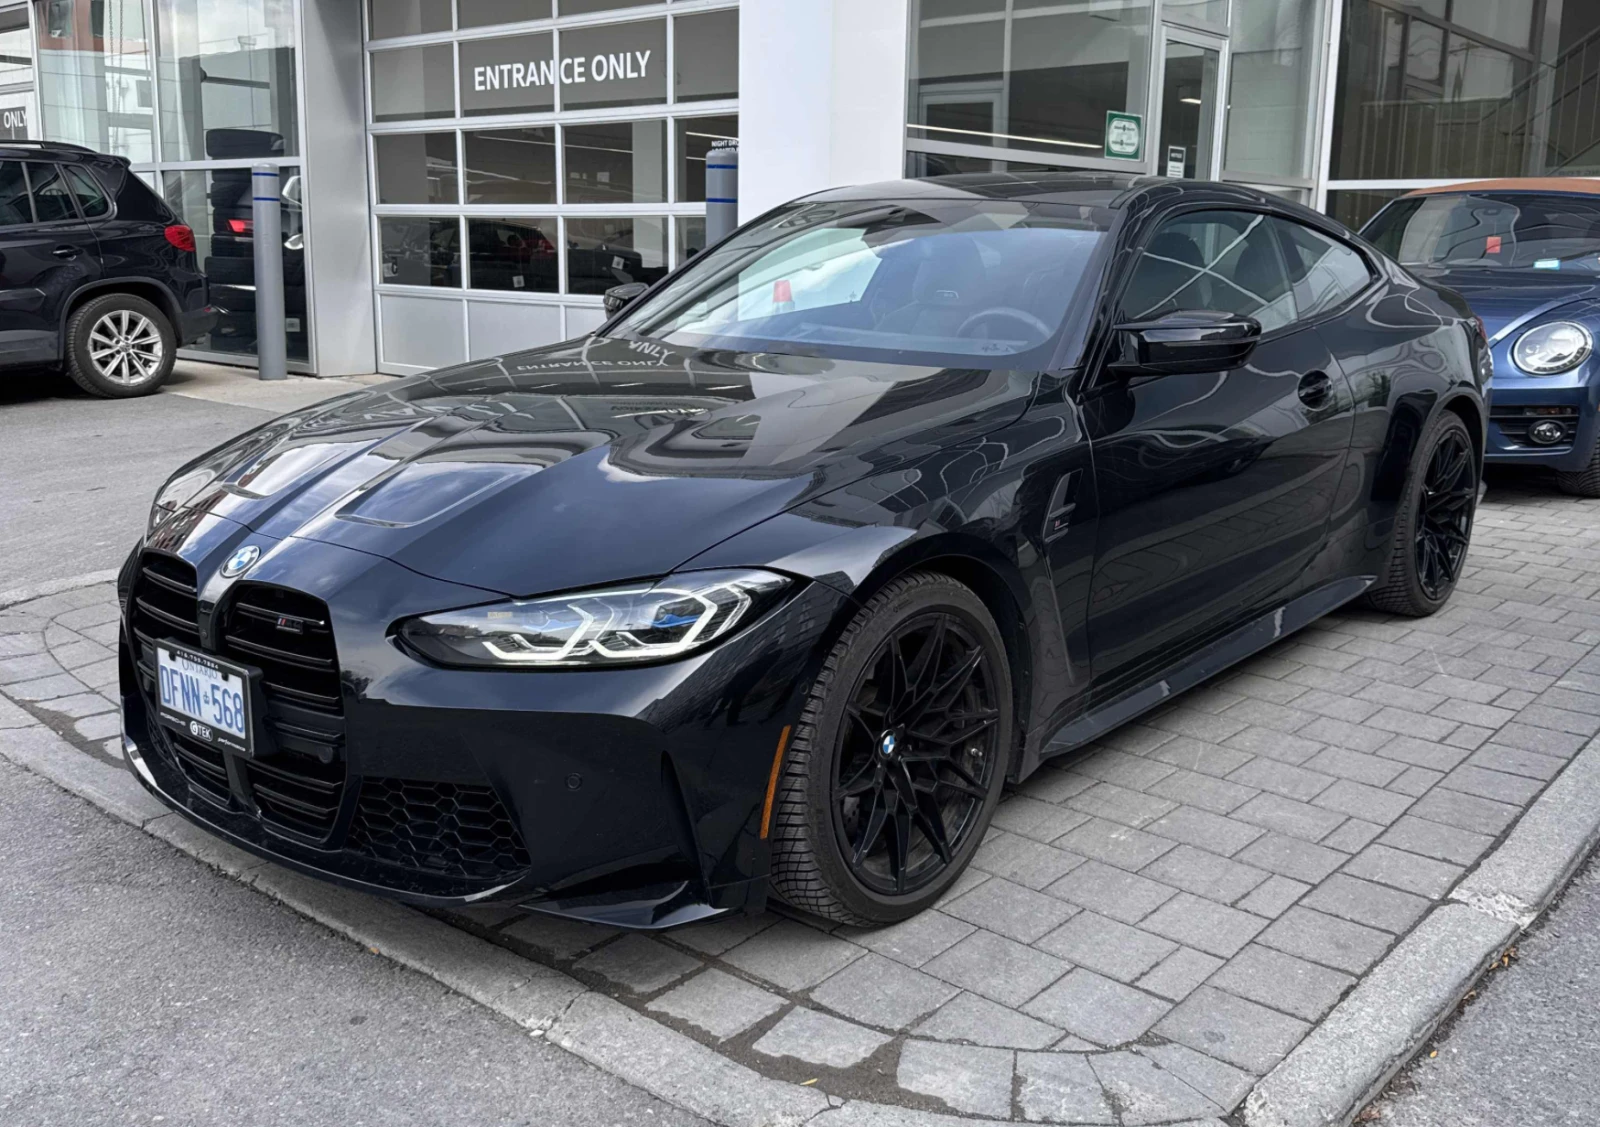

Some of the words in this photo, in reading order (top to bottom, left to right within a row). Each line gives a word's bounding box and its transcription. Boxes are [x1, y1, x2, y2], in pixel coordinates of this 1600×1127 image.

[474, 57, 586, 91] ENTRANCE
[591, 50, 651, 82] ONLY
[3, 110, 27, 129] ONLY
[160, 665, 202, 717] DFNN
[210, 683, 245, 733] 568
